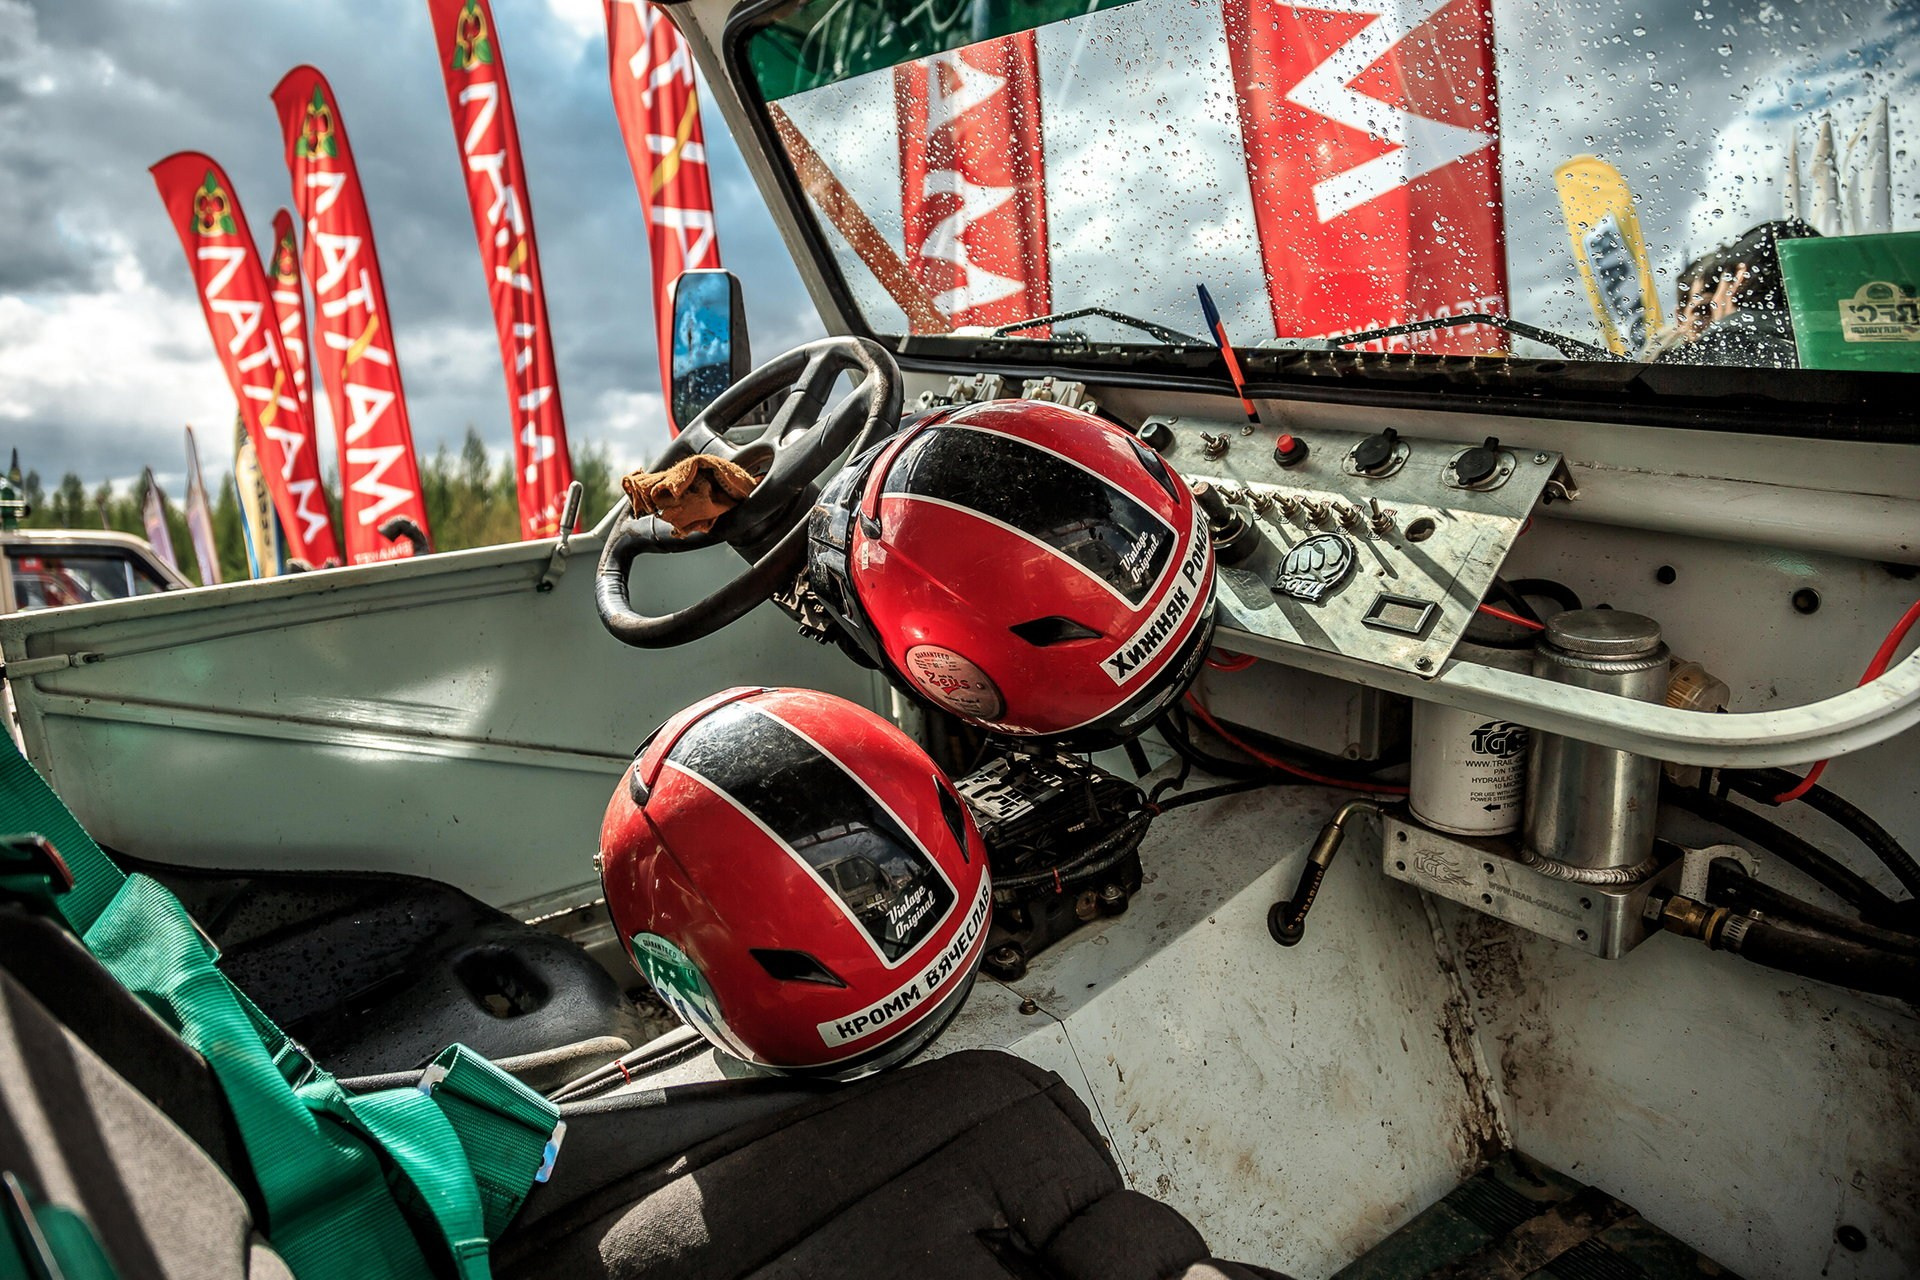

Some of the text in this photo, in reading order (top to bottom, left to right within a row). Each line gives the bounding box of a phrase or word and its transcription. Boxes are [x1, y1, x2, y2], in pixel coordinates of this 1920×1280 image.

[1119, 531, 1148, 571] Vintage
[1130, 533, 1160, 583] Original
[1471, 775, 1513, 784] HYDRAULIC
[886, 884, 926, 925] Vintage
[895, 890, 936, 940] Original
[835, 884, 991, 1039] КРОММ ВЯЧЕСЛАВ
